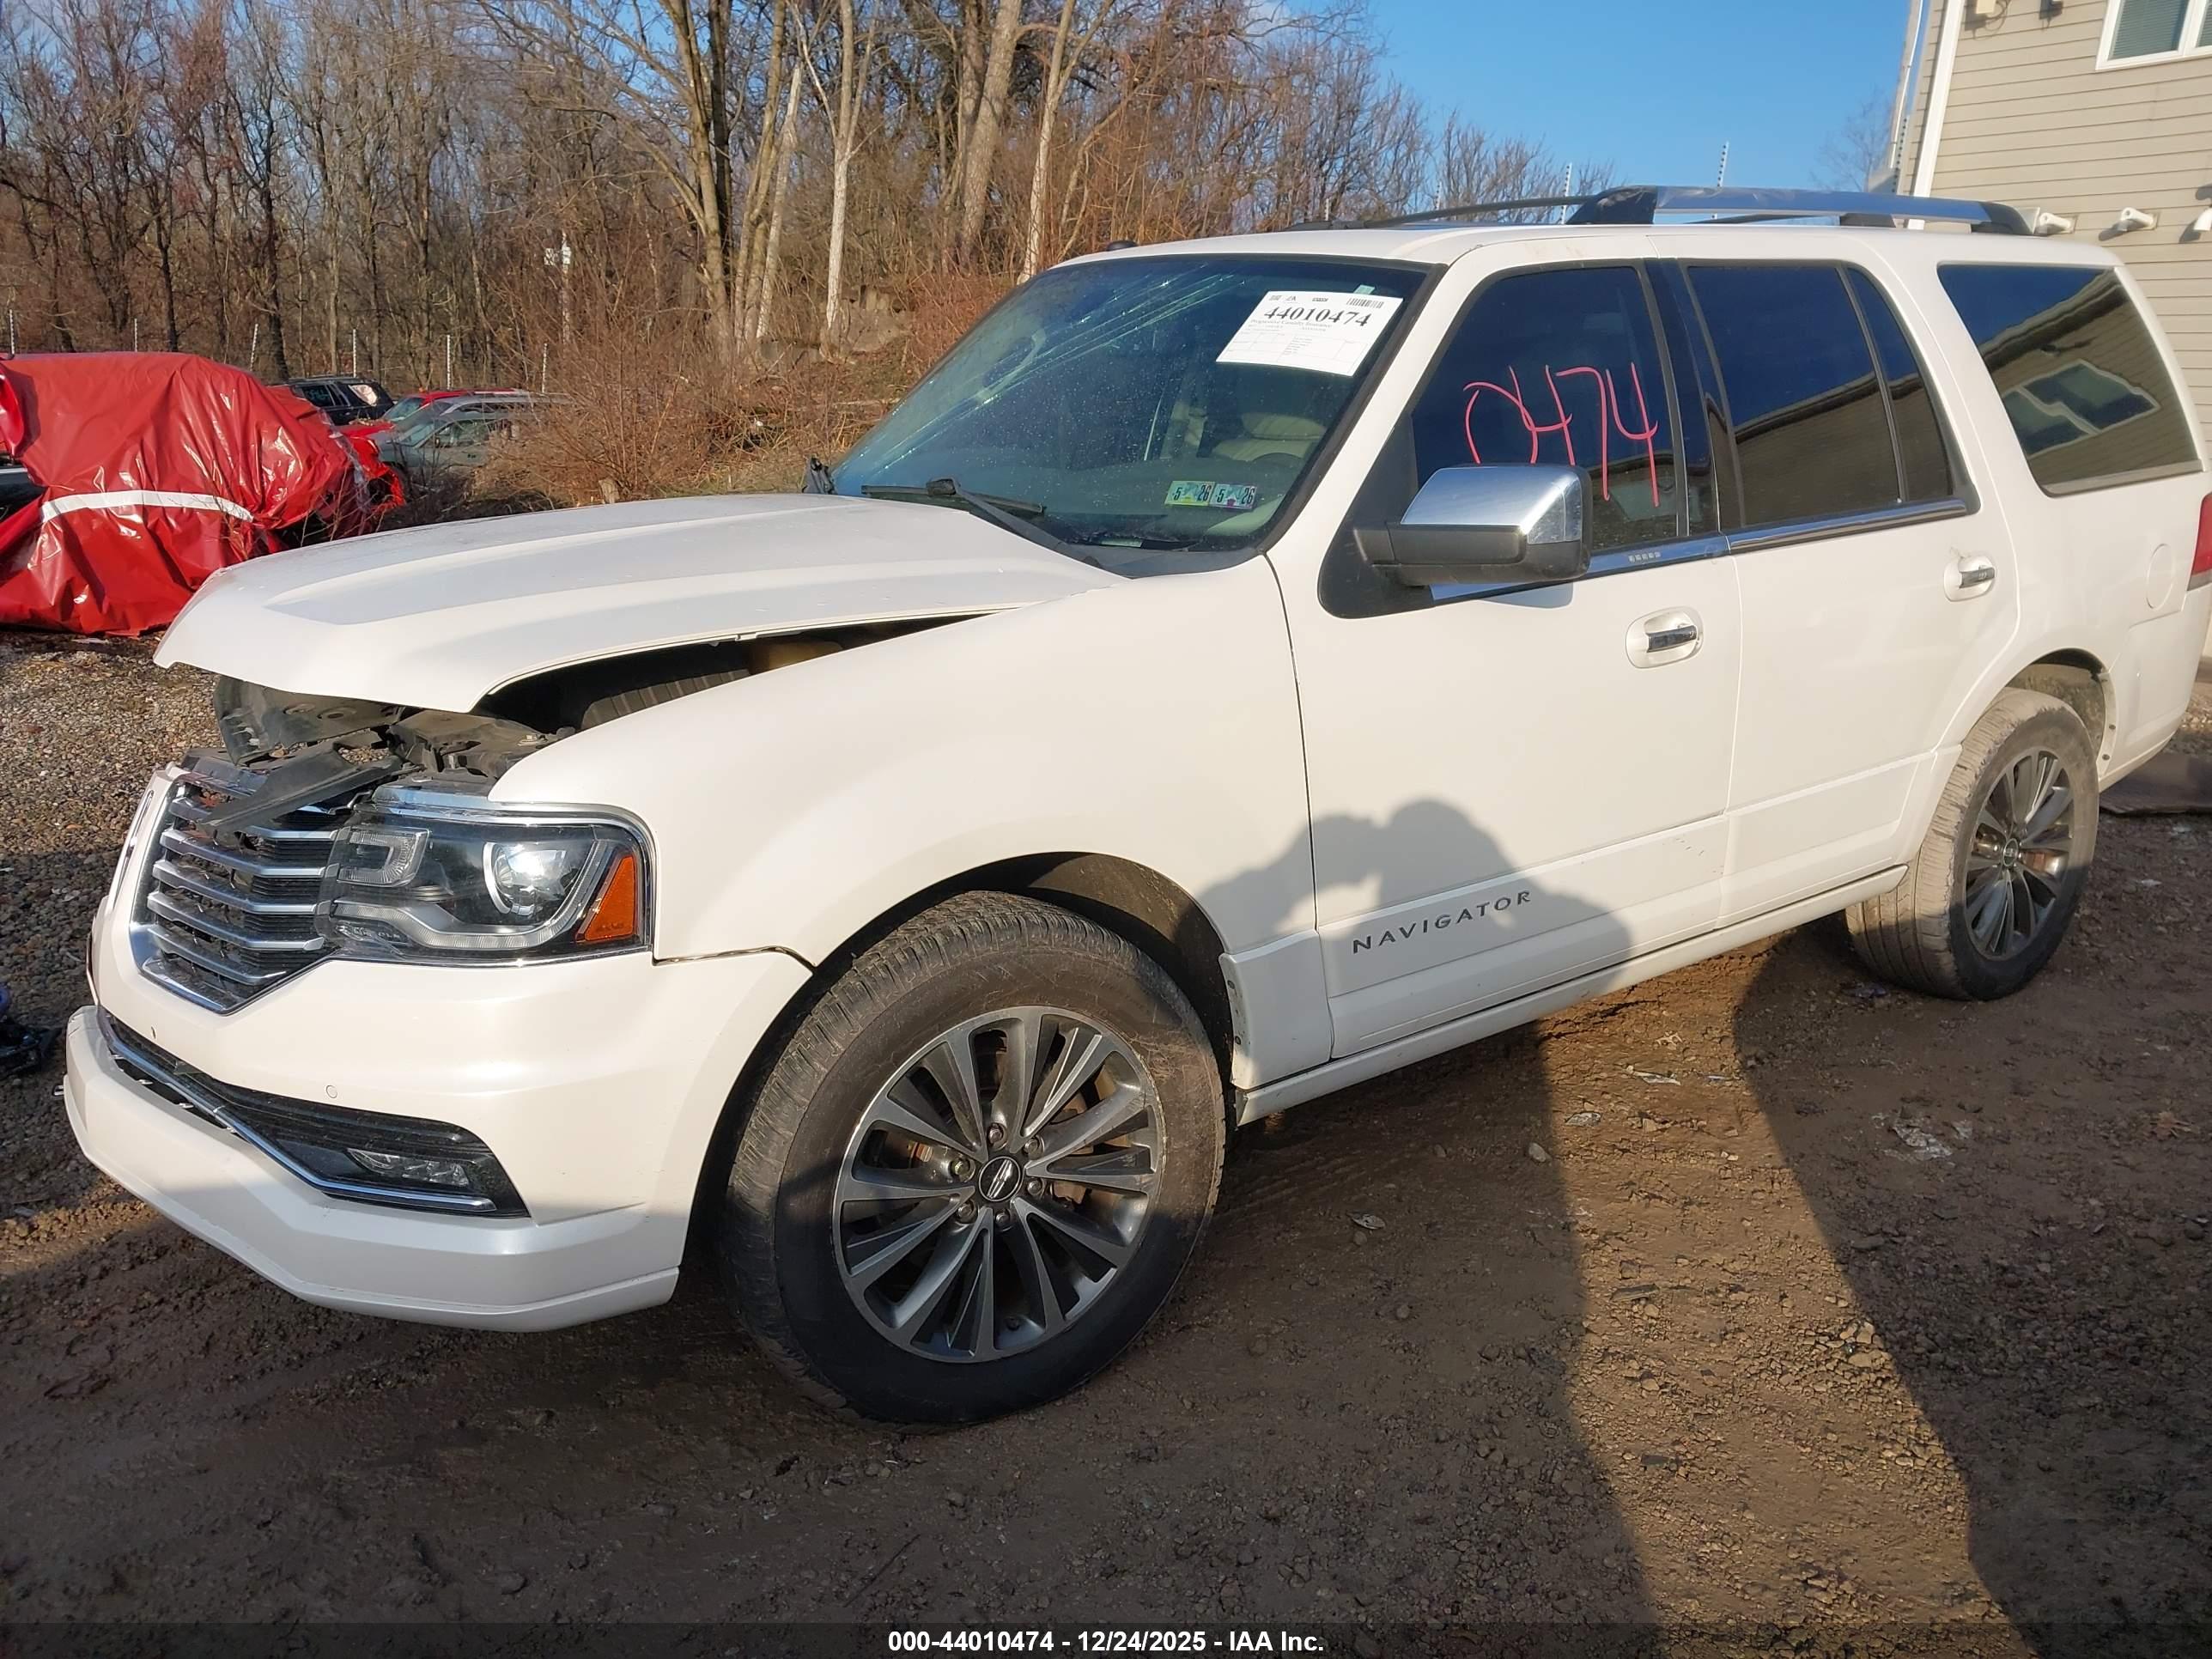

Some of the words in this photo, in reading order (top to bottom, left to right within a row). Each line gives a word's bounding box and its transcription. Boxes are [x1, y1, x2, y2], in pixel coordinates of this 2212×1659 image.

[1264, 306, 1372, 327] 44010474
[1463, 362, 1659, 508] 0474
[1174, 487, 1182, 501] 5
[1198, 485, 1212, 501] 26
[1217, 489, 1225, 503] 5
[1241, 488, 1255, 505] 26
[1352, 890, 1532, 954] NAVIGATOR
